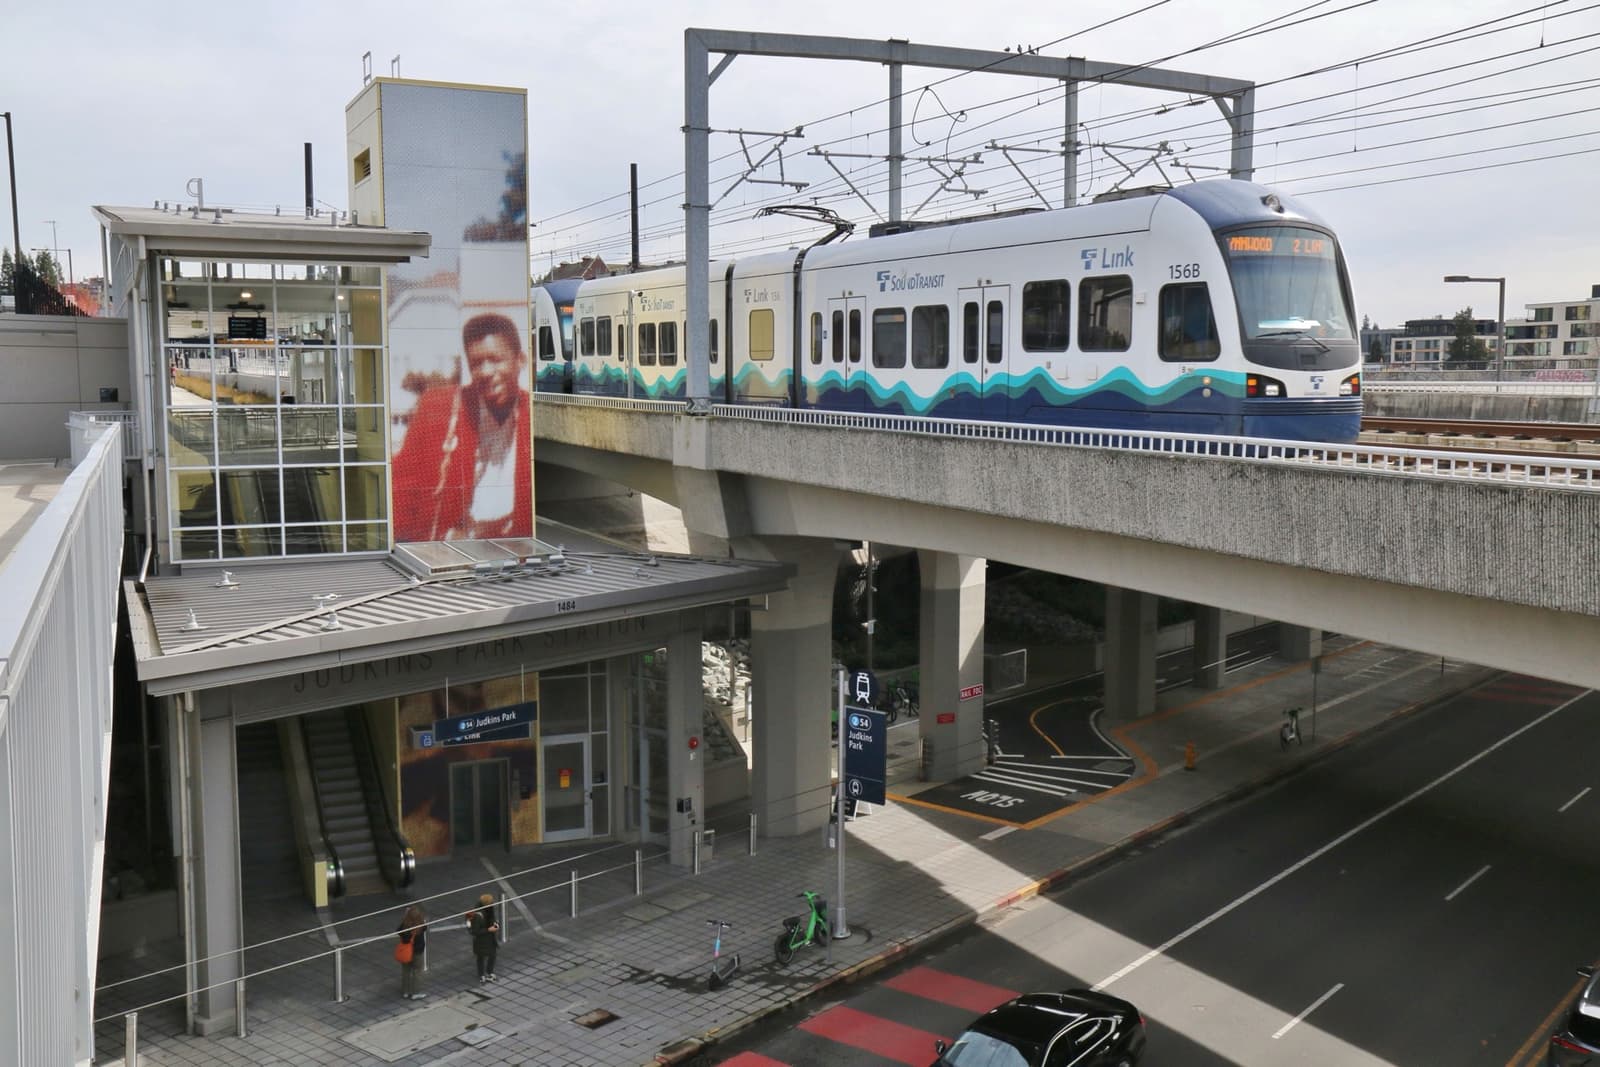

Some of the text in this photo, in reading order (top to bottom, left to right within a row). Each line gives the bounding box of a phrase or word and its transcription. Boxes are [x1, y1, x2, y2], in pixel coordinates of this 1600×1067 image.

[1102, 245, 1134, 269] Link
[1169, 263, 1201, 280] 156B
[753, 288, 769, 303] Link
[557, 600, 576, 612] 1484
[476, 714, 501, 728] Judkins
[502, 710, 517, 722] Park
[849, 730, 873, 742] Judkins
[849, 740, 863, 750] Park
